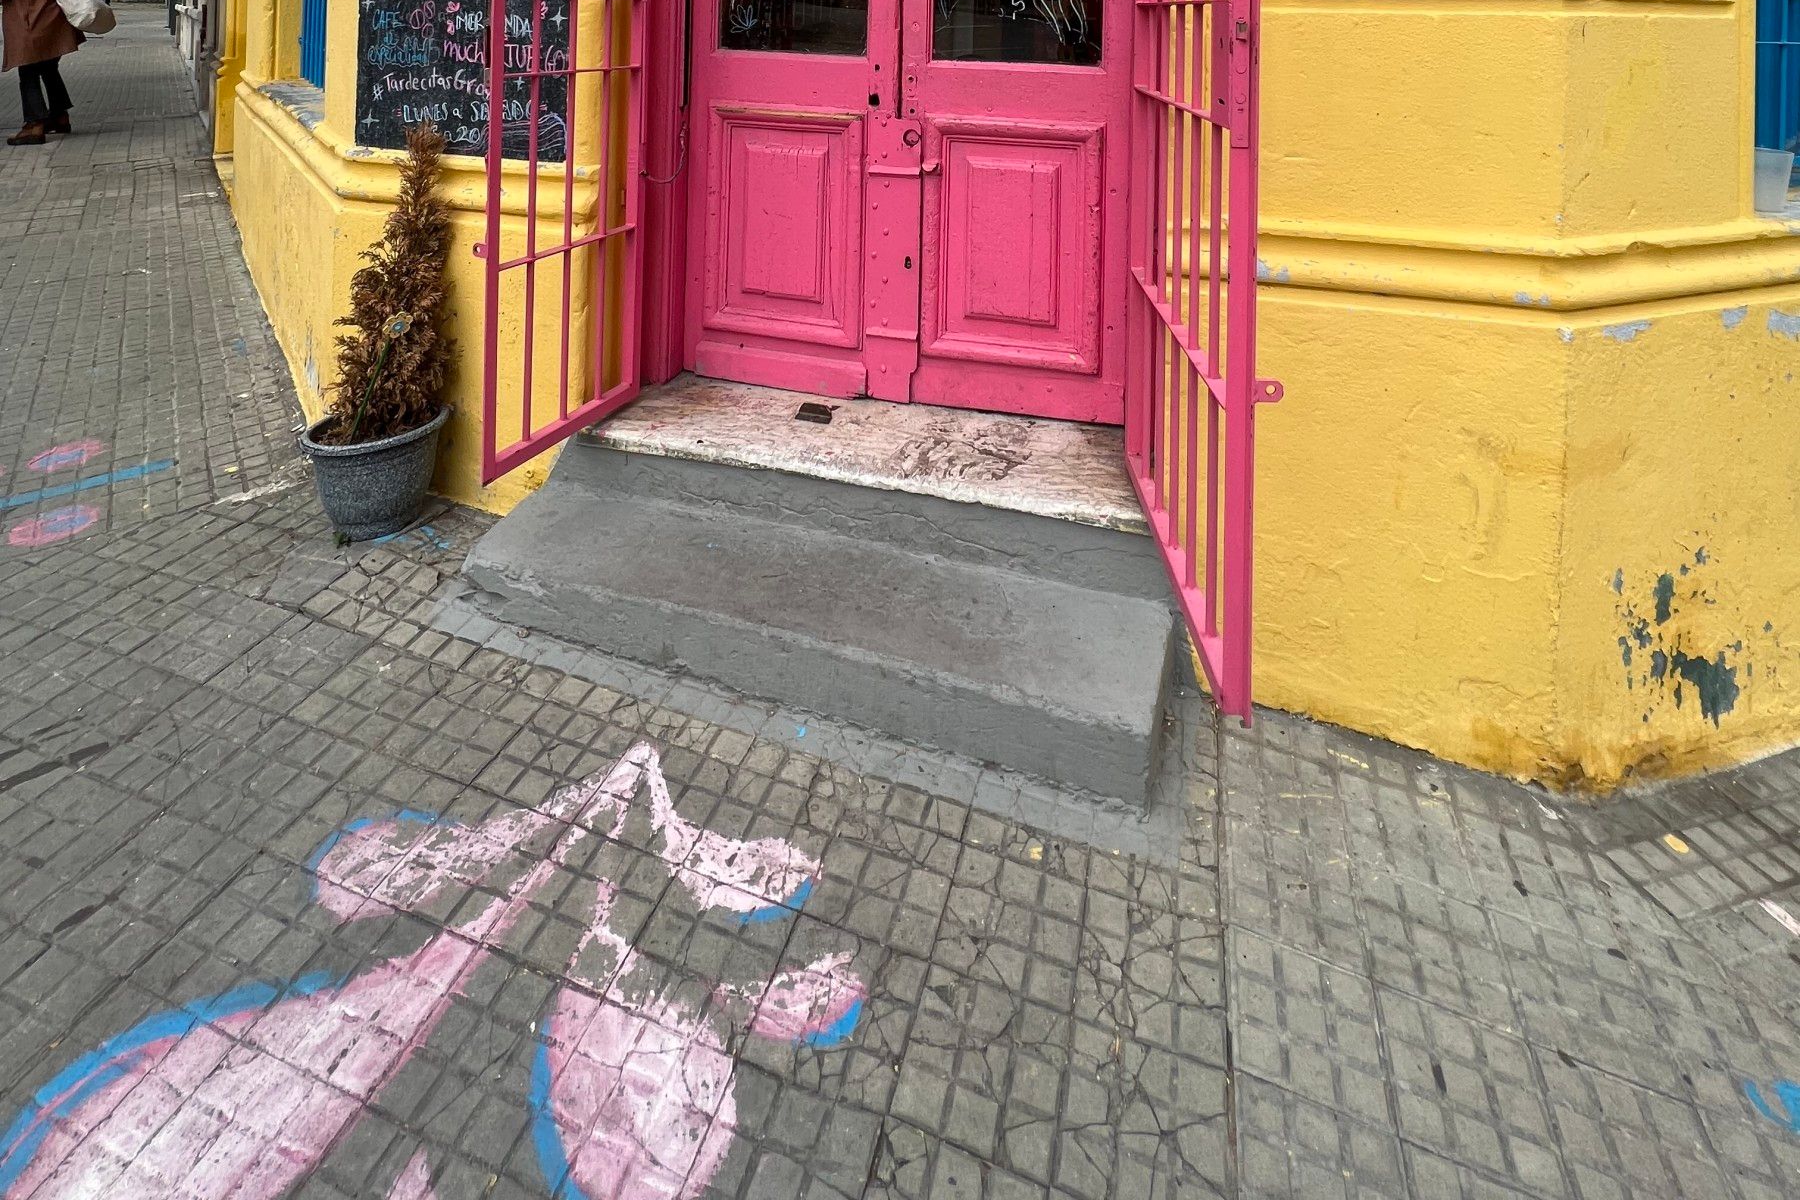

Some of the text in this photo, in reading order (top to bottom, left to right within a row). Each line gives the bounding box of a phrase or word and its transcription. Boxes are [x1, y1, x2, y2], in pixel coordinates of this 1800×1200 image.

[455, 11, 533, 38] MERNDA
[443, 39, 486, 64] much
[470, 99, 532, 123] SAAD
